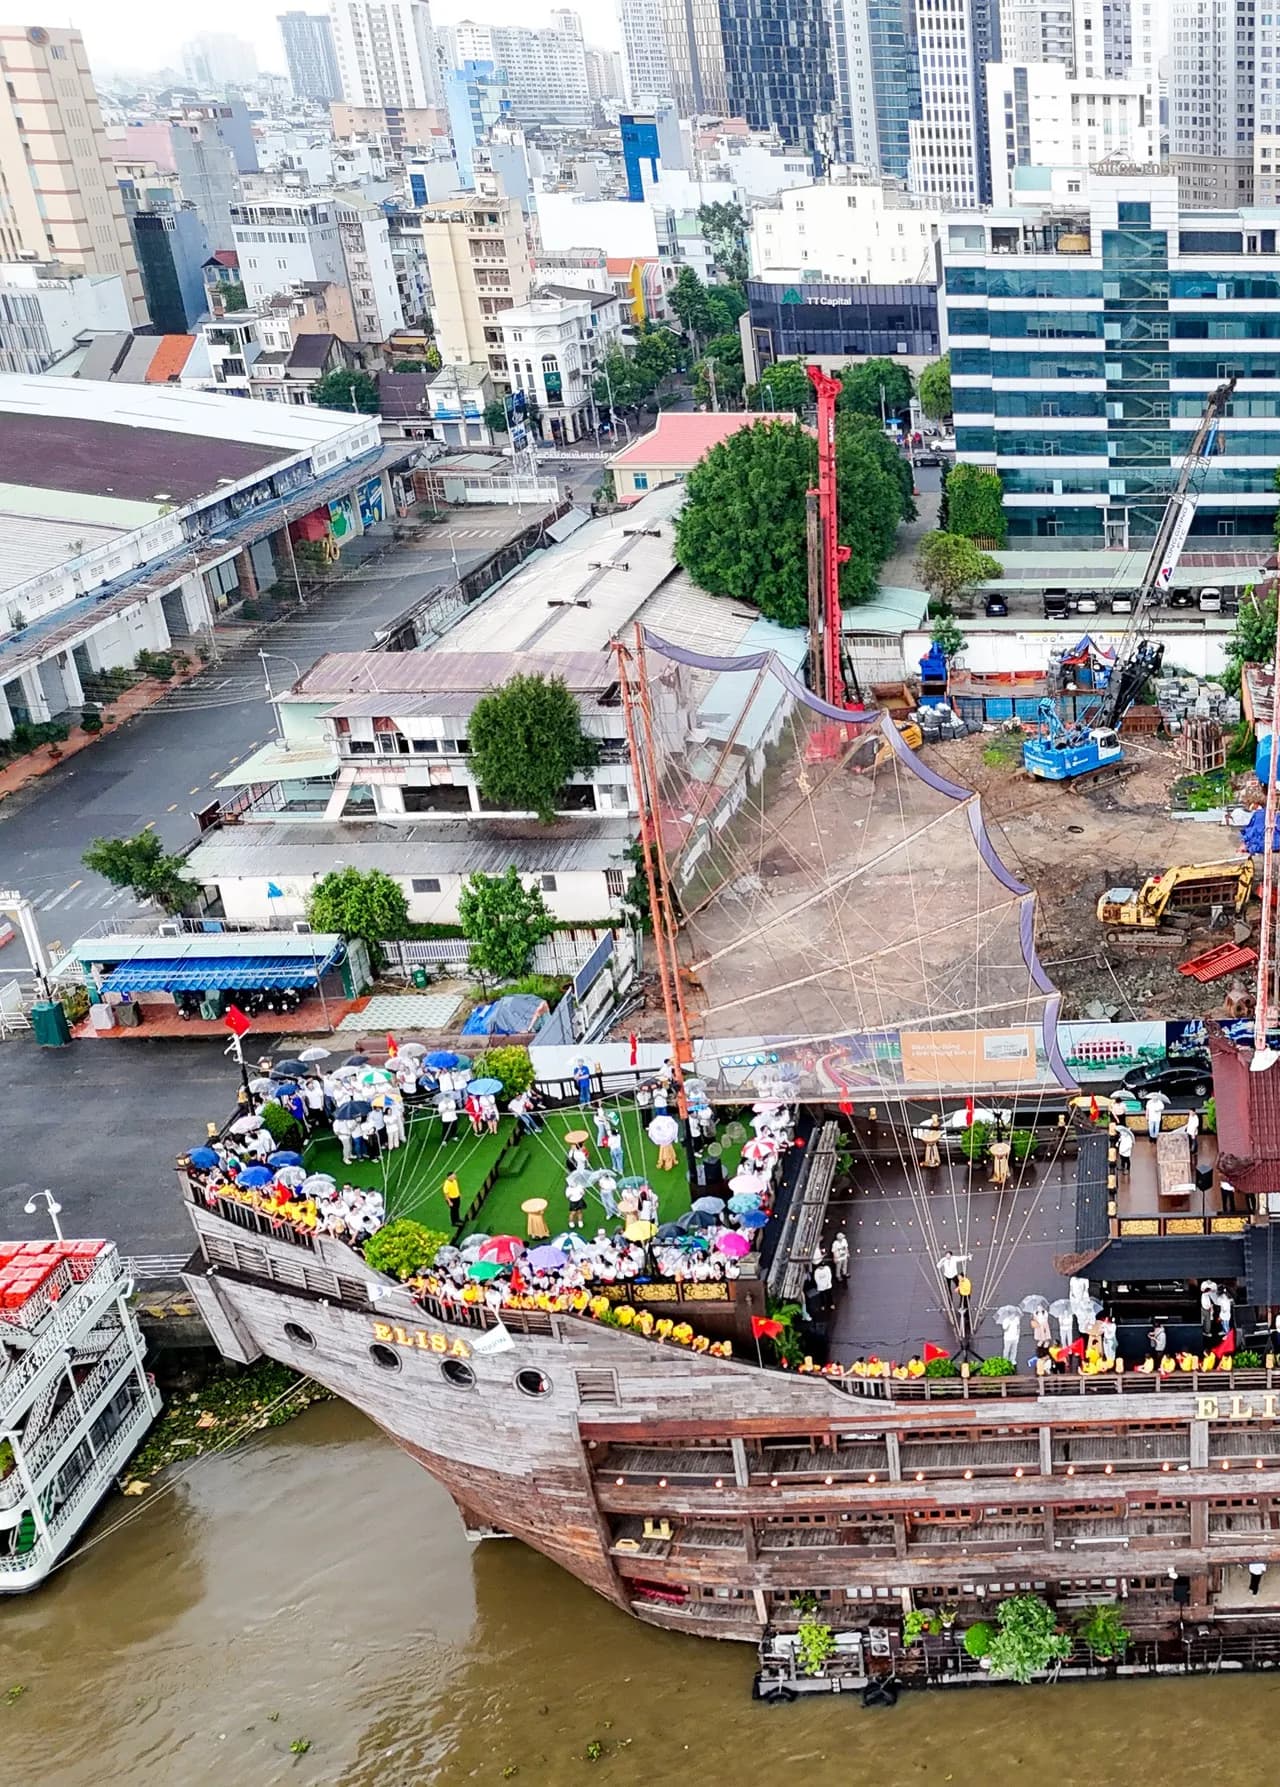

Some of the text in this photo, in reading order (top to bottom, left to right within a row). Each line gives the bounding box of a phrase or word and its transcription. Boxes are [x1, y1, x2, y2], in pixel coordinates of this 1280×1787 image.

[807, 297, 853, 308] TT Capital
[373, 1321, 473, 1359] ELISA
